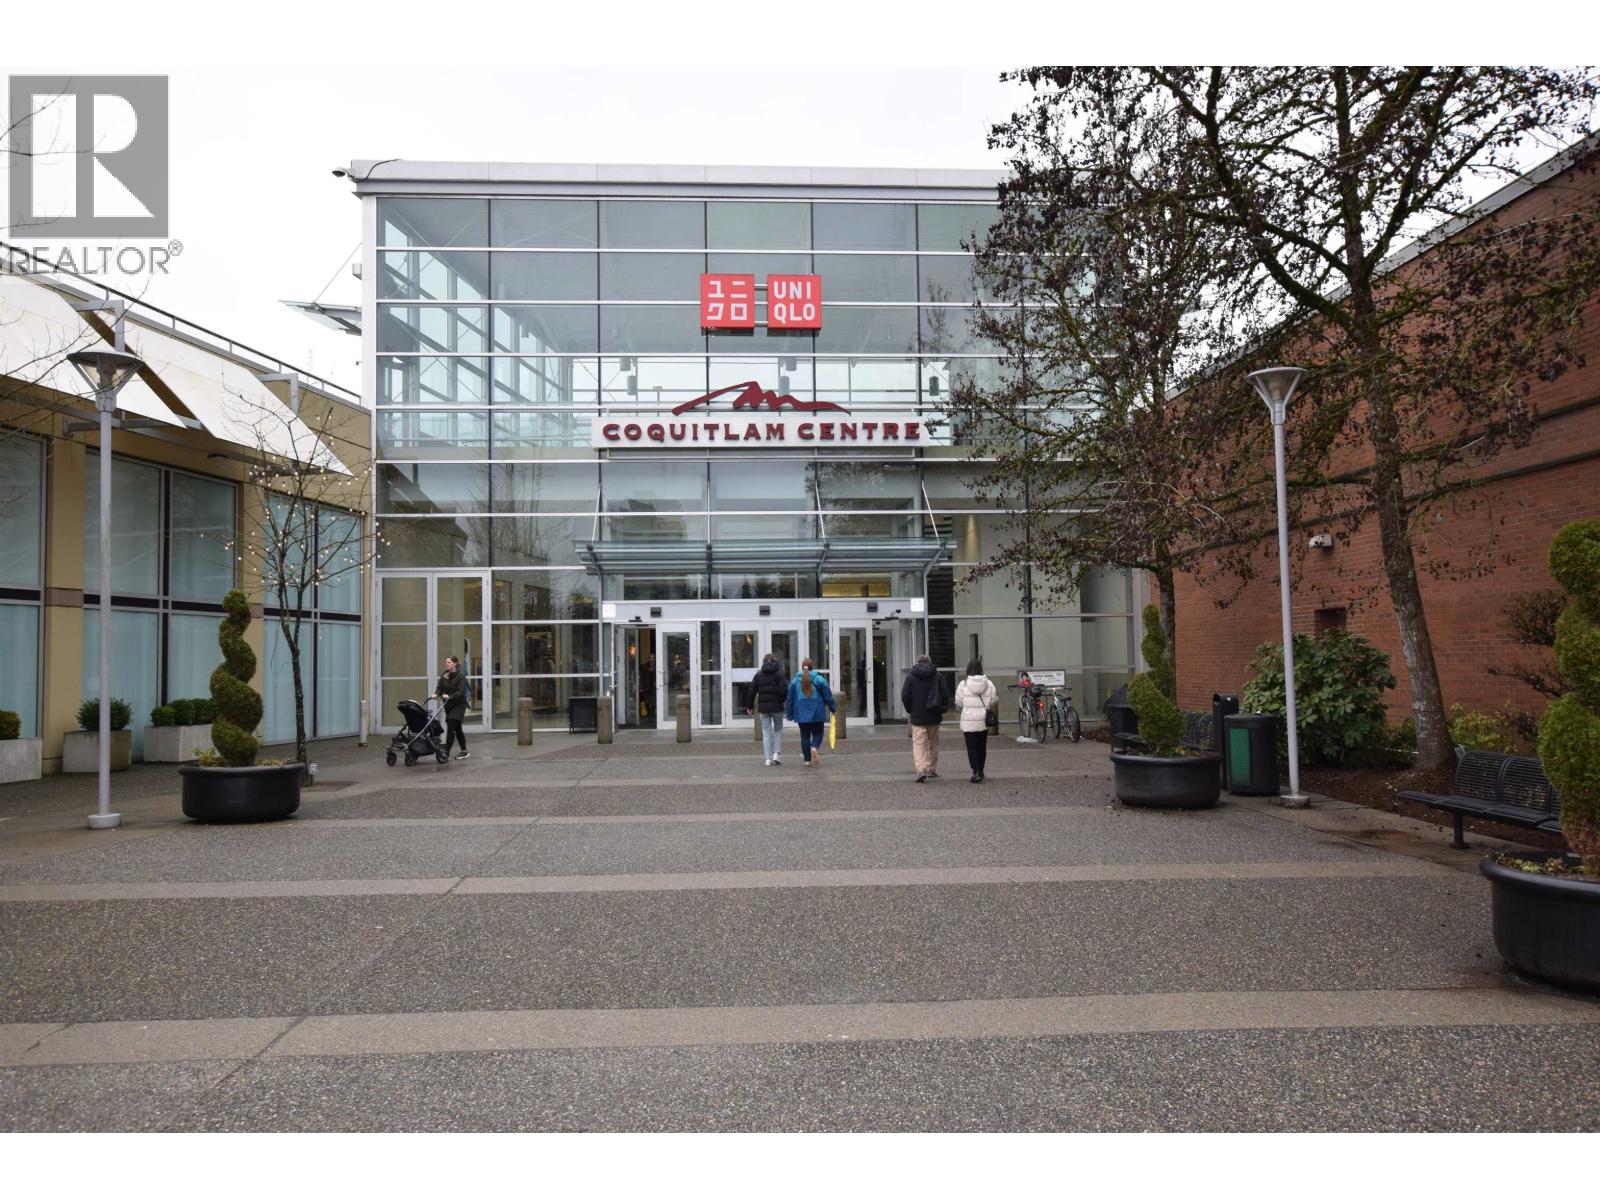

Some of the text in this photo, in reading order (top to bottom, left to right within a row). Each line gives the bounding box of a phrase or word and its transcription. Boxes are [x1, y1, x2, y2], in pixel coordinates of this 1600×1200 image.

[774, 281, 812, 299] UNI
[774, 302, 816, 324] QLO
[602, 422, 920, 442] COQUITLAM CENTRE
